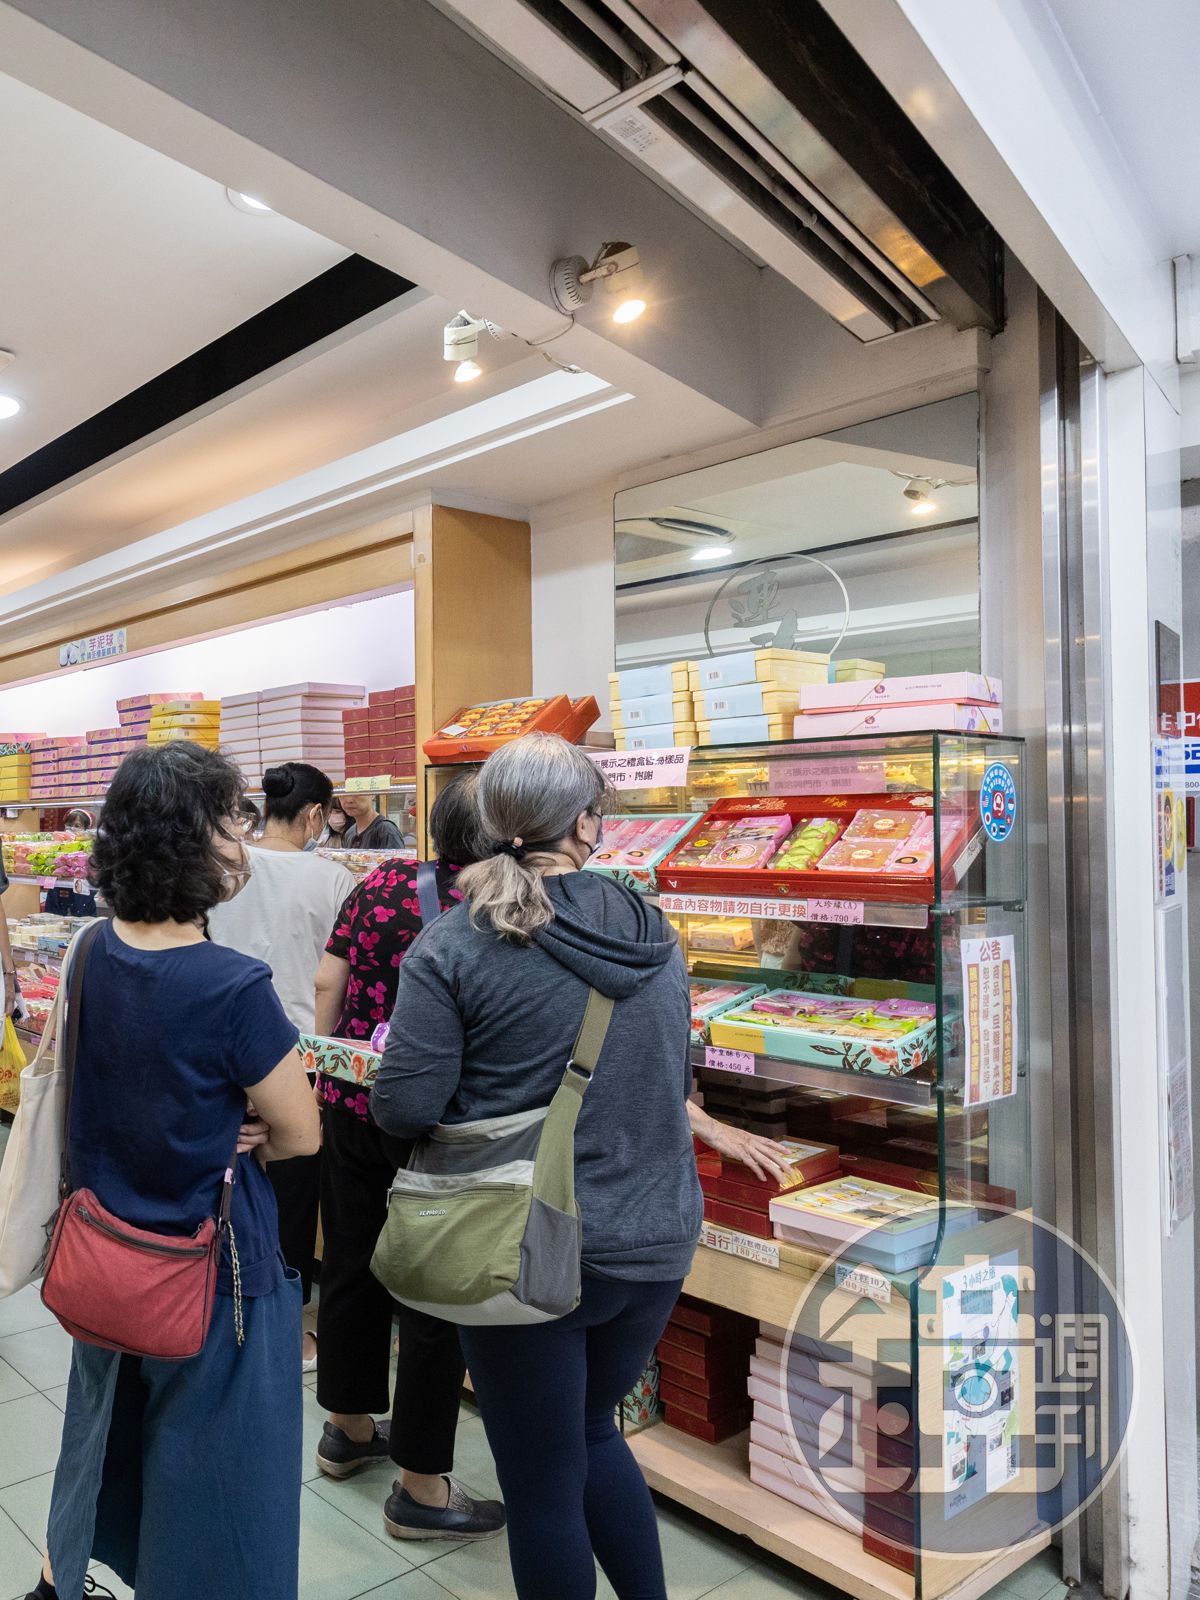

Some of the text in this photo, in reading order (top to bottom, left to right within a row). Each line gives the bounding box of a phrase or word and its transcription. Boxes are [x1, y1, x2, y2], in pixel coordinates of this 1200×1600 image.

[88, 633, 114, 651] 芋泥球
[661, 896, 807, 918] 禮盒內容物請勿自行更換
[980, 940, 1001, 961] 公告
